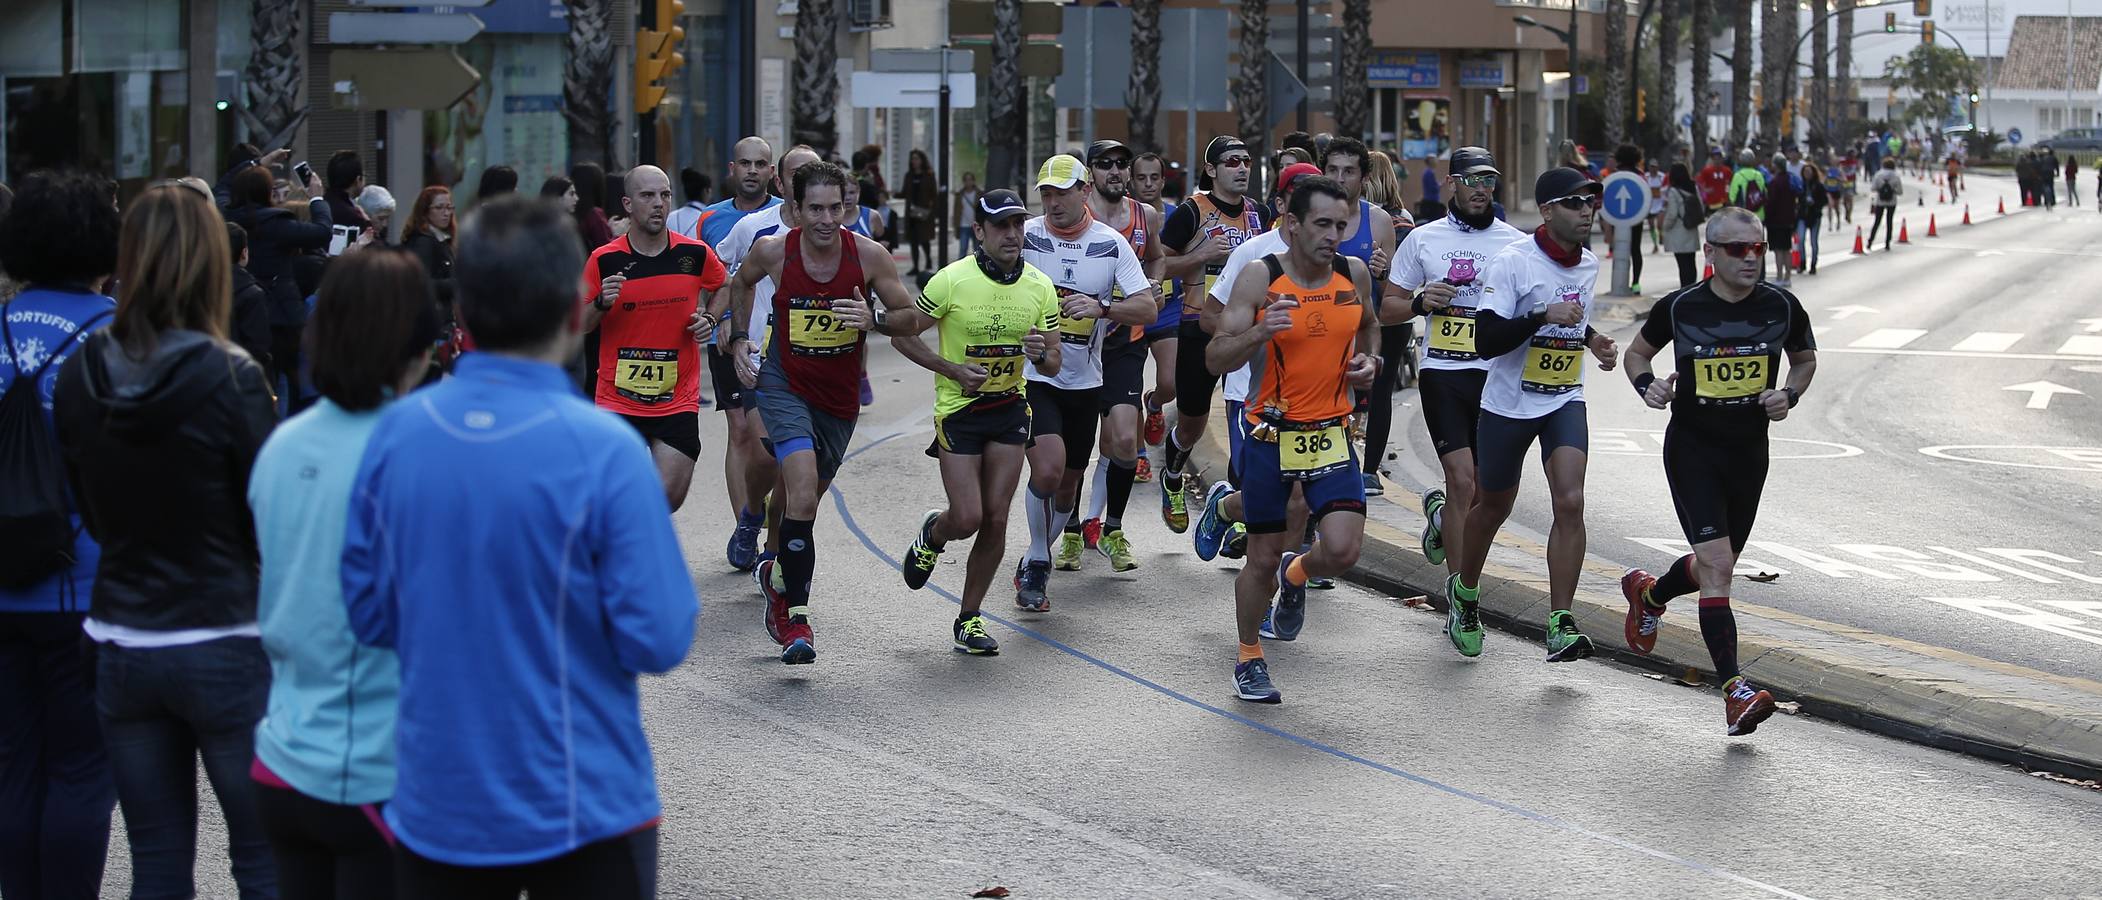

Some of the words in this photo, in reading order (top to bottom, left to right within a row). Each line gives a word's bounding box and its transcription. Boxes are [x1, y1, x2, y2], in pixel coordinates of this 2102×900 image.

[1441, 250, 1487, 262] COCHINOS
[804, 314, 847, 332] 792
[1441, 320, 1475, 338] 871
[1539, 353, 1576, 372] 867
[1703, 360, 1761, 382] 1052
[628, 364, 664, 381] 741
[1293, 433, 1333, 454] 386
